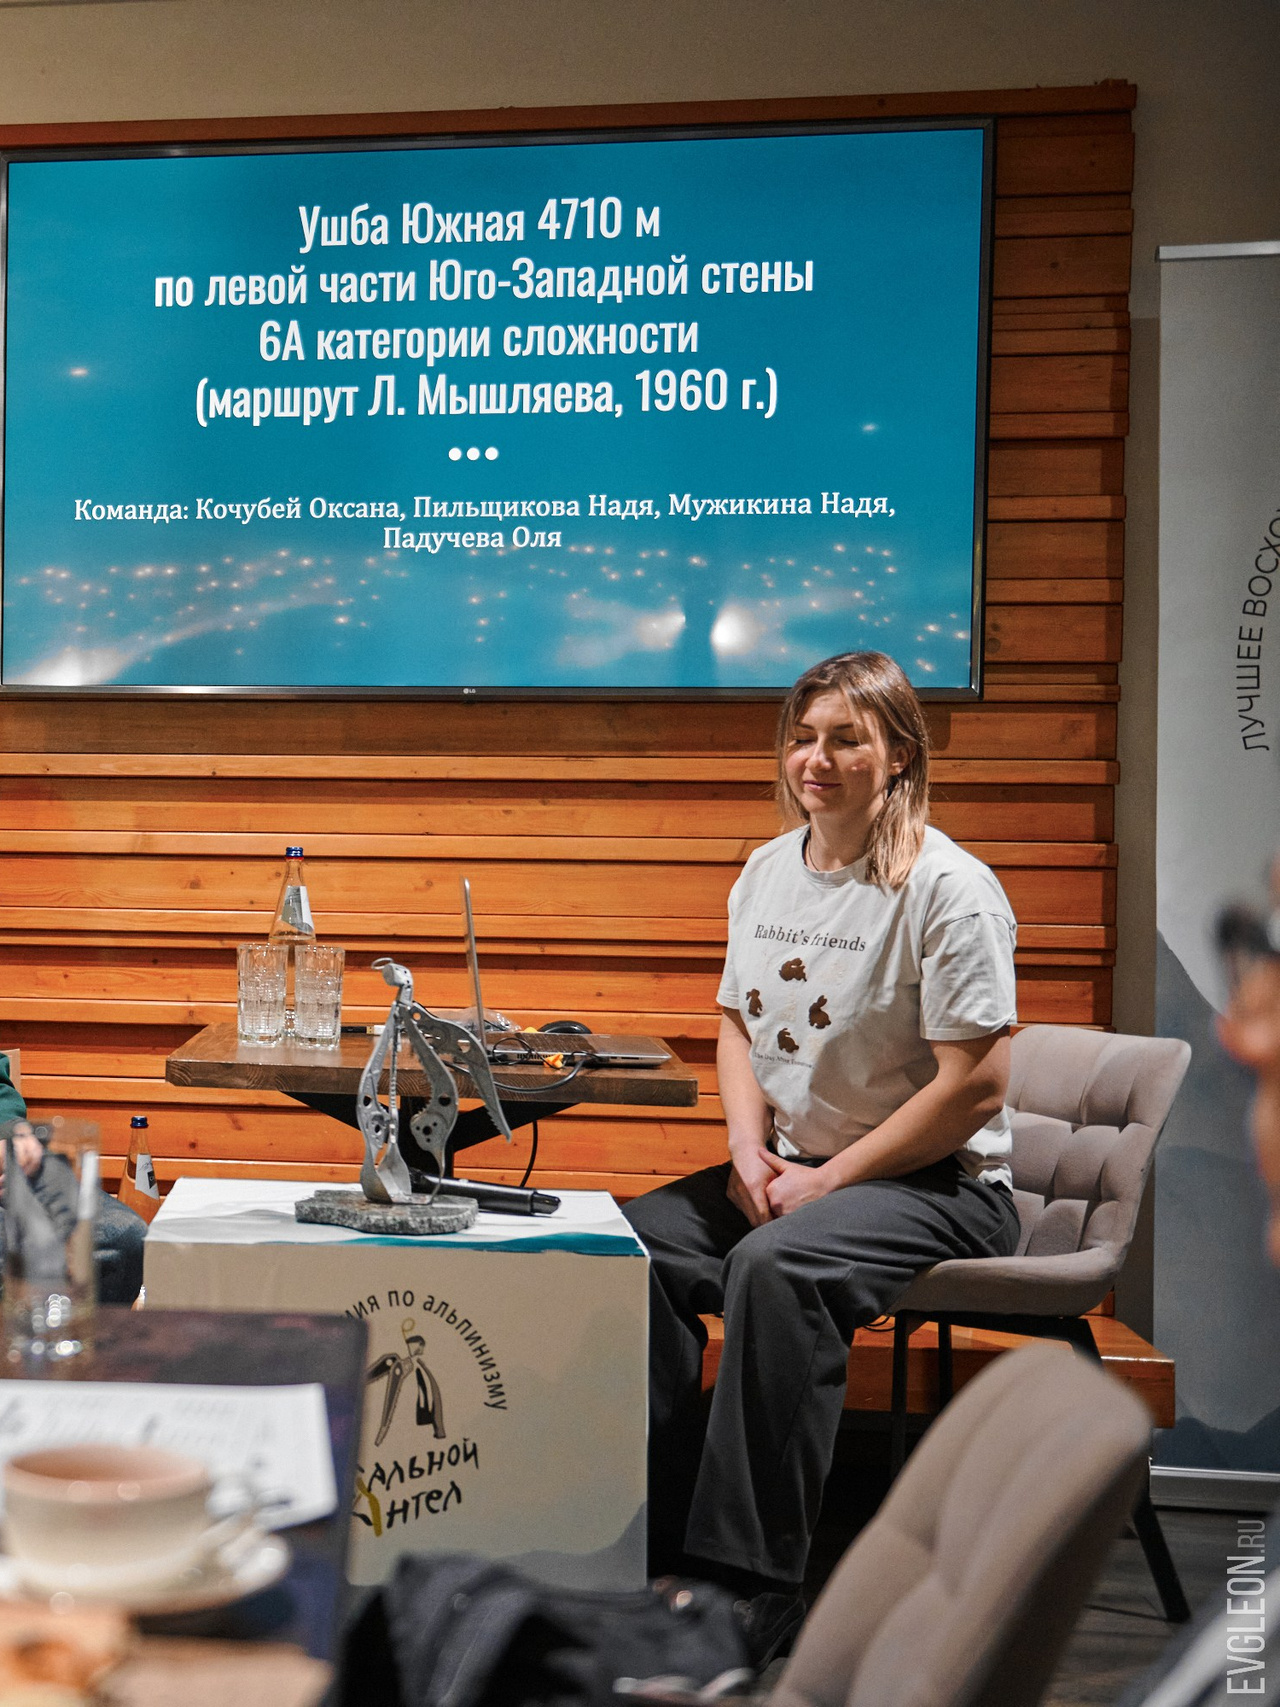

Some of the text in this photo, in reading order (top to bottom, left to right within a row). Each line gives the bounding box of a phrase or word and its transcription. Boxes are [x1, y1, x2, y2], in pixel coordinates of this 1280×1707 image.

[298, 197, 660, 253] Ушба Южная 4710 м
[154, 254, 814, 308] по левой части Юго-Западной стены
[259, 320, 699, 367] 6А категории сложности
[196, 367, 778, 428] (маршрут Л. Мышляева, 1960 г.)
[74, 491, 897, 525] Команда: Кочубей Оксана, Пильщикова Надя, Мужикина Надя,
[383, 526, 562, 555] Падучева Оля
[1236, 509, 1280, 751] ЛУЧШЕЕ ВОСХО
[754, 924, 867, 952] Rabbit's friends
[388, 1290, 415, 1307] по
[422, 1295, 508, 1411] альпинизму
